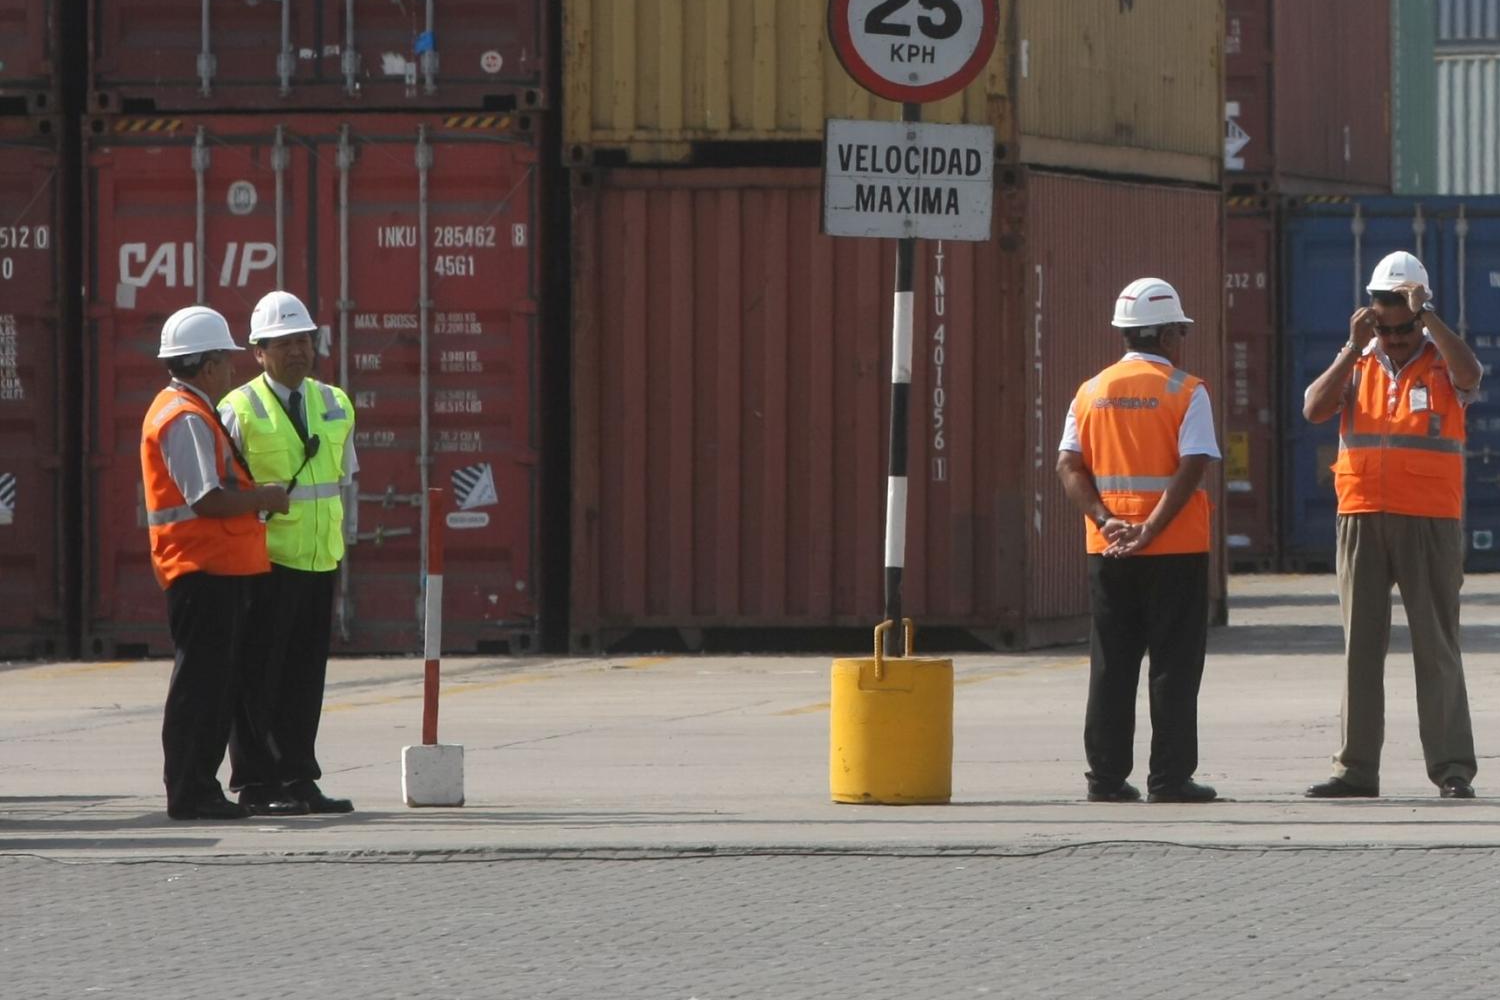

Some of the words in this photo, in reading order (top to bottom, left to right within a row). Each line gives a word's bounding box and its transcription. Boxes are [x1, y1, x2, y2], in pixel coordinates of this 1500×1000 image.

[889, 43, 936, 65] KPH
[837, 143, 982, 177] VELOCIDAD
[854, 183, 960, 216] MAXIMA
[377, 226, 416, 248] INKU
[434, 226, 496, 248] 285462
[434, 255, 475, 276] 45G1
[383, 313, 418, 329] GROSS
[933, 323, 945, 450] 401056
